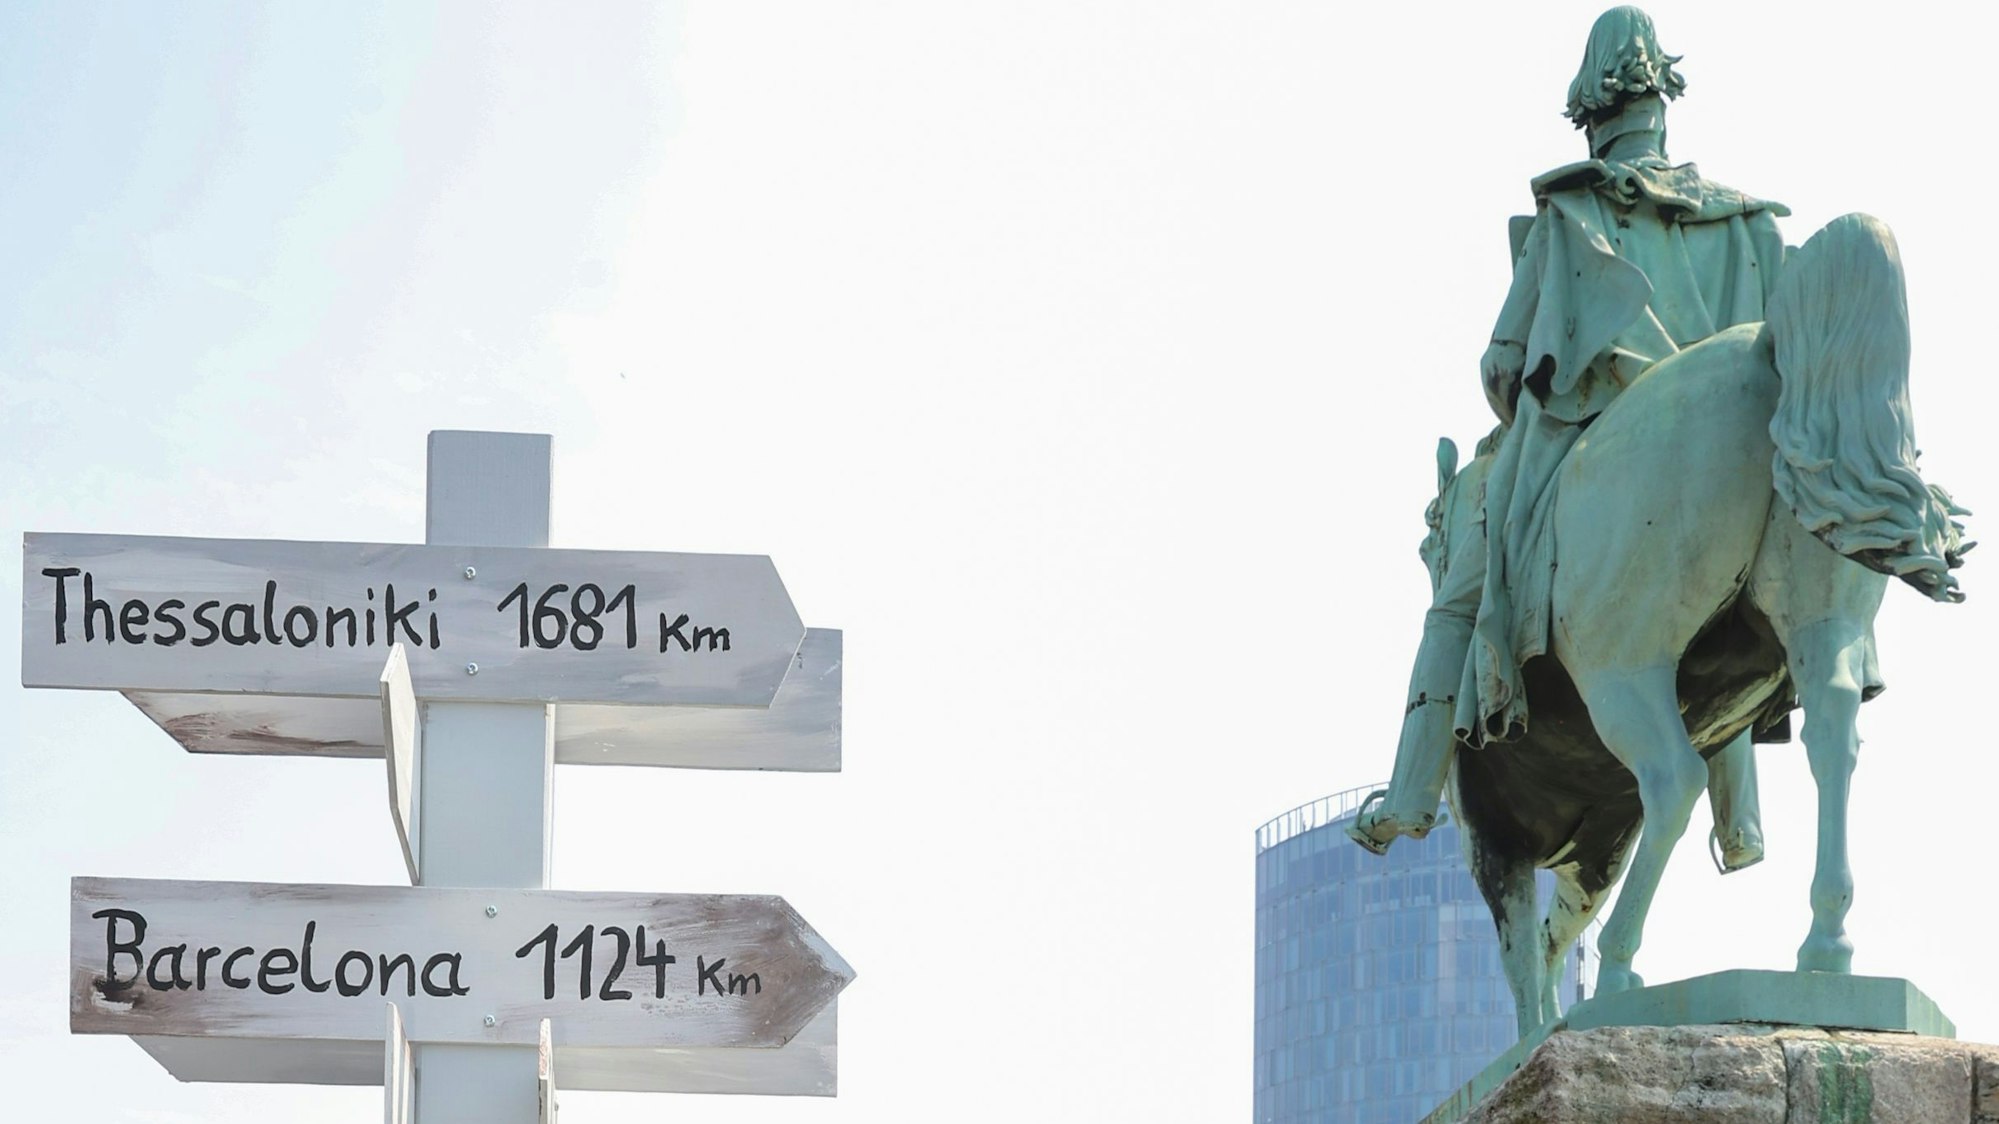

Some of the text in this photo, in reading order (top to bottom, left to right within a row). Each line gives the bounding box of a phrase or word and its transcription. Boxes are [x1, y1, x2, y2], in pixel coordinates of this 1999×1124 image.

[42, 567, 439, 650] Thessaloniki
[497, 582, 638, 651] 1681
[91, 908, 470, 1002] Barcelona
[515, 923, 677, 1001] 1124
